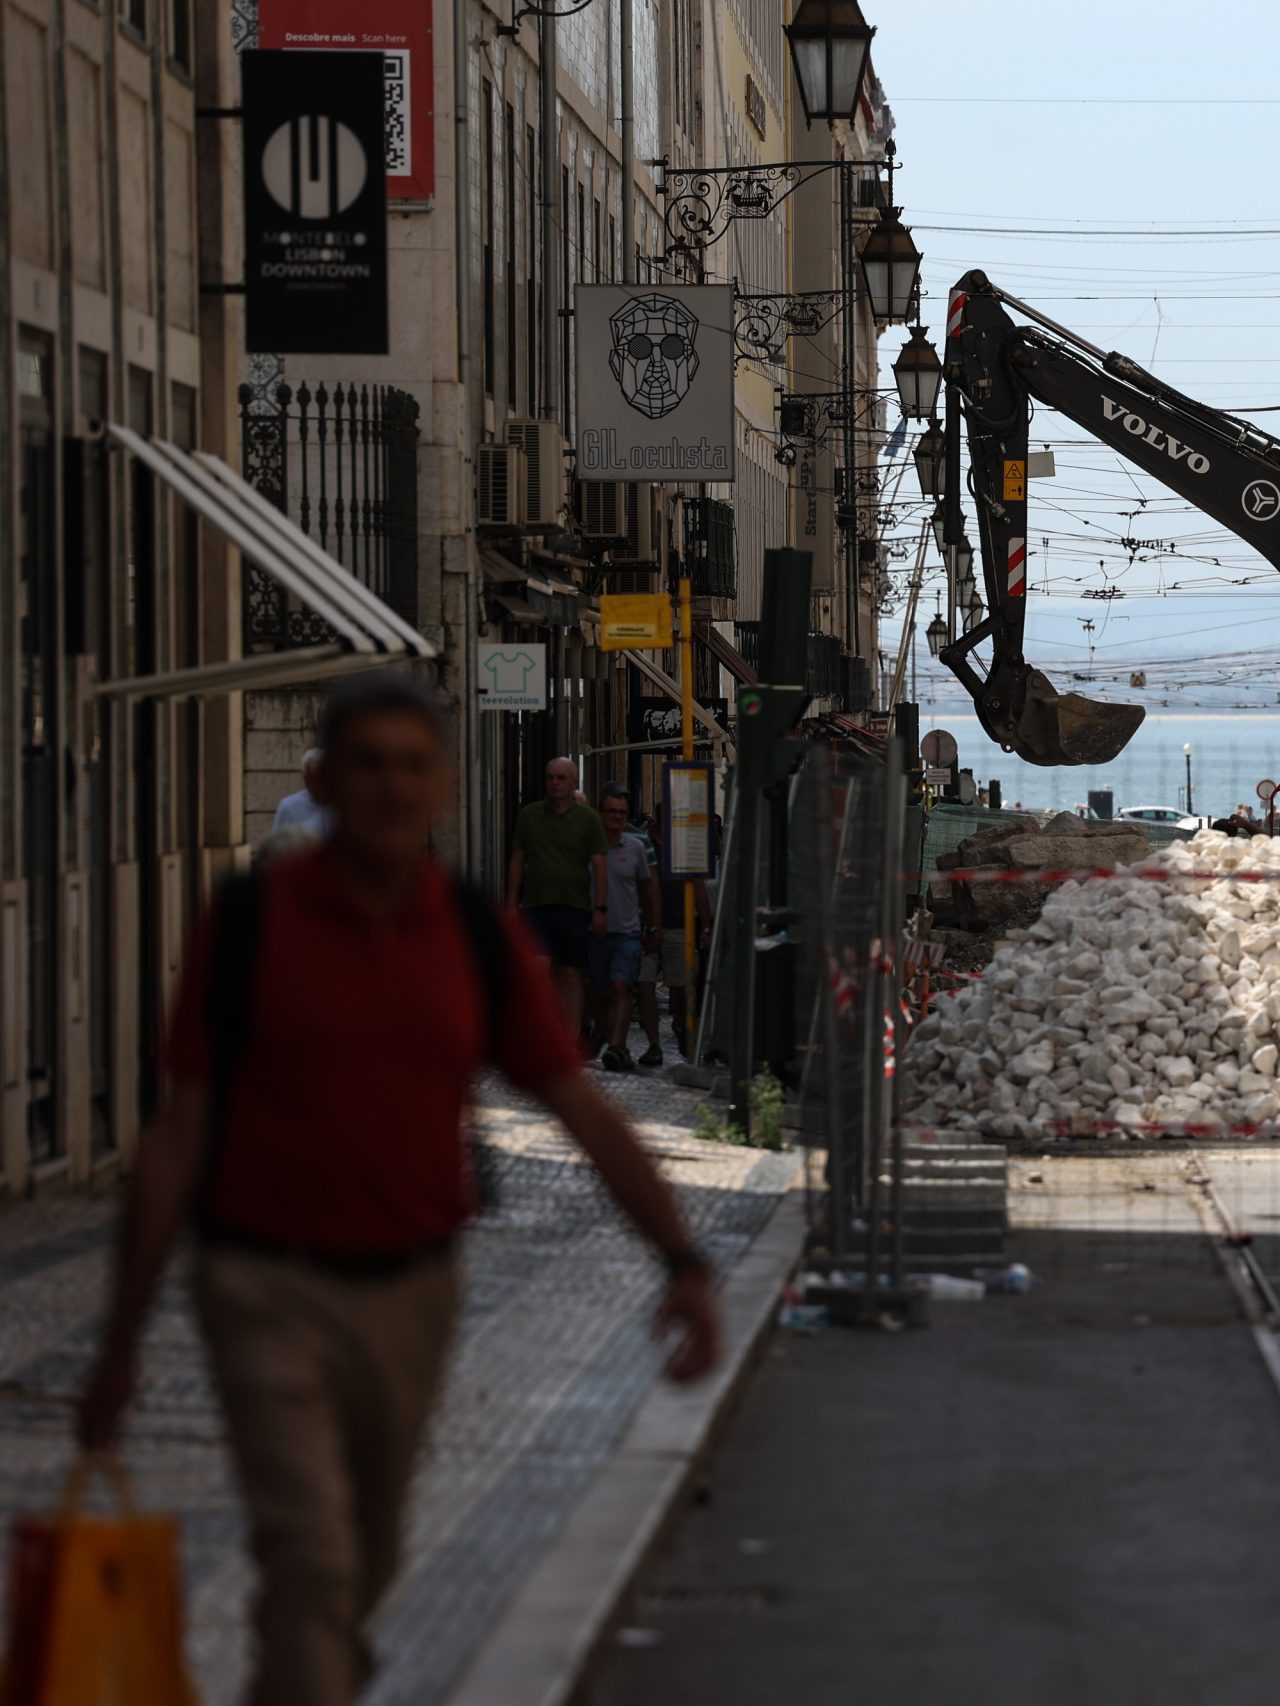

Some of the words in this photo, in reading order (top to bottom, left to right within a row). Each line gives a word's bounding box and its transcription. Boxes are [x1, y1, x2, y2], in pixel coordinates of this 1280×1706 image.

[285, 32, 329, 42] Descobre
[332, 32, 356, 42] mais
[362, 33, 384, 43] Scan
[385, 33, 407, 43] here
[262, 231, 368, 246] MONTEBELO
[284, 247, 346, 262] LISBON
[260, 262, 371, 278] DOWNTOWN
[1100, 394, 1211, 474] VOLVO
[582, 428, 627, 470] GIL
[630, 436, 728, 470] oculista
[482, 696, 539, 705] teevolution
